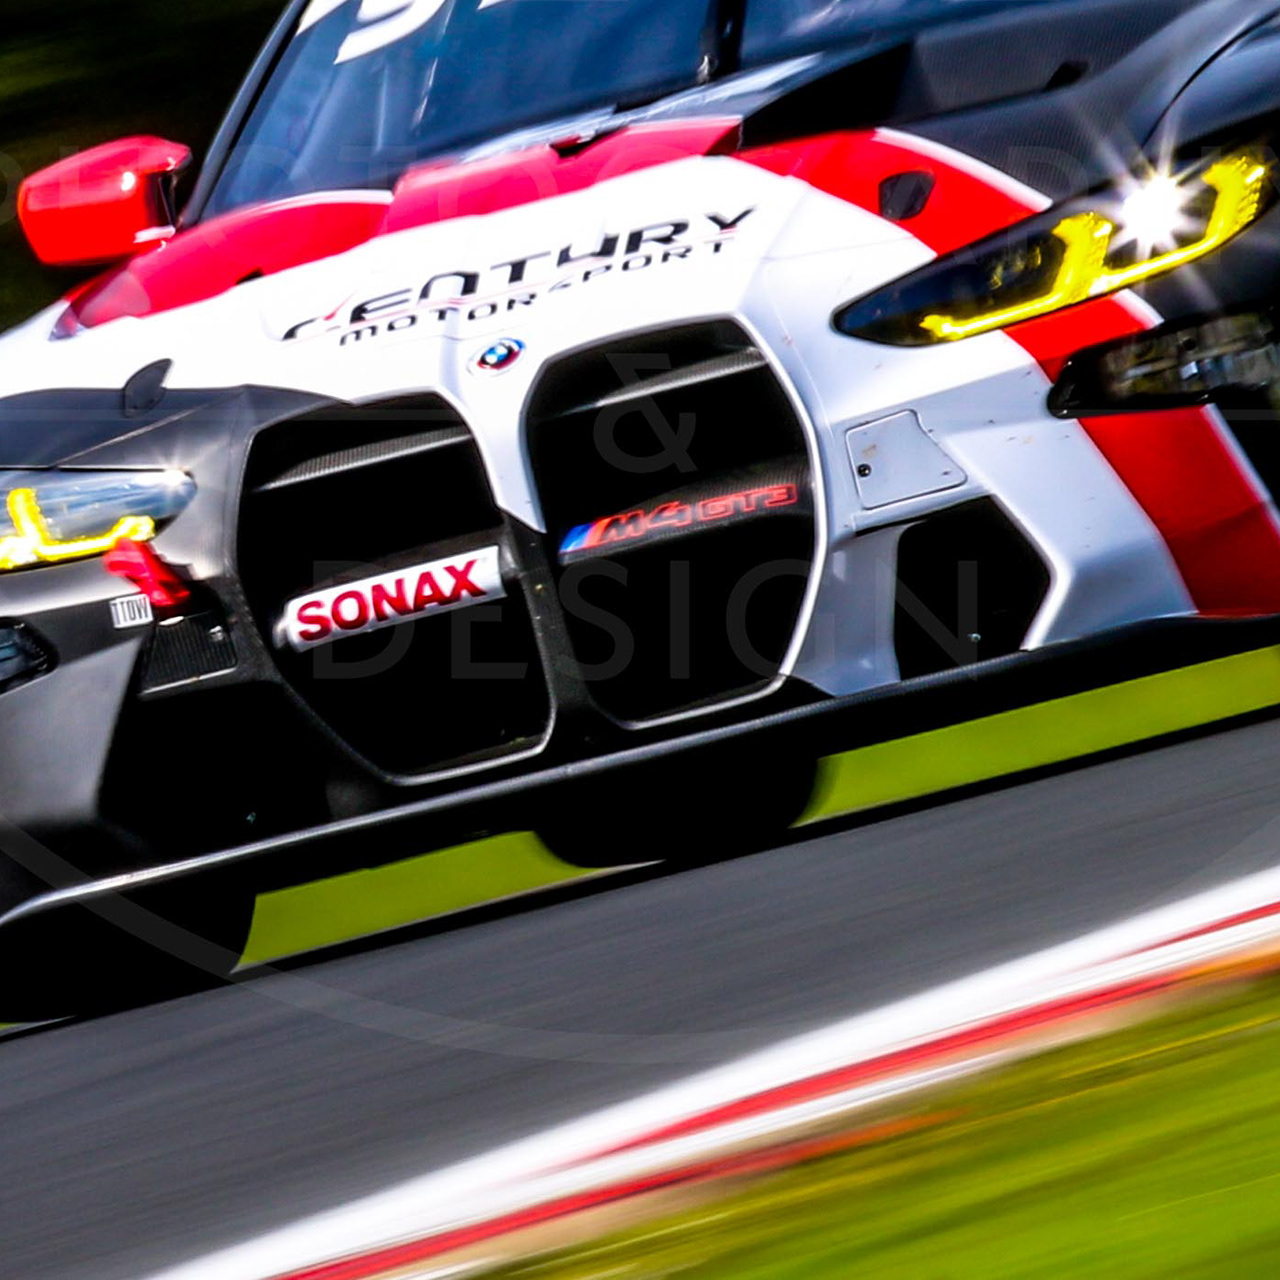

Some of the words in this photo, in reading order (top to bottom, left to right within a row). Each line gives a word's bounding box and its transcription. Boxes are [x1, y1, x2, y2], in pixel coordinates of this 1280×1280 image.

[282, 205, 758, 342] CENTURY
[696, 482, 799, 522] GT3
[296, 557, 488, 642] SONAX
